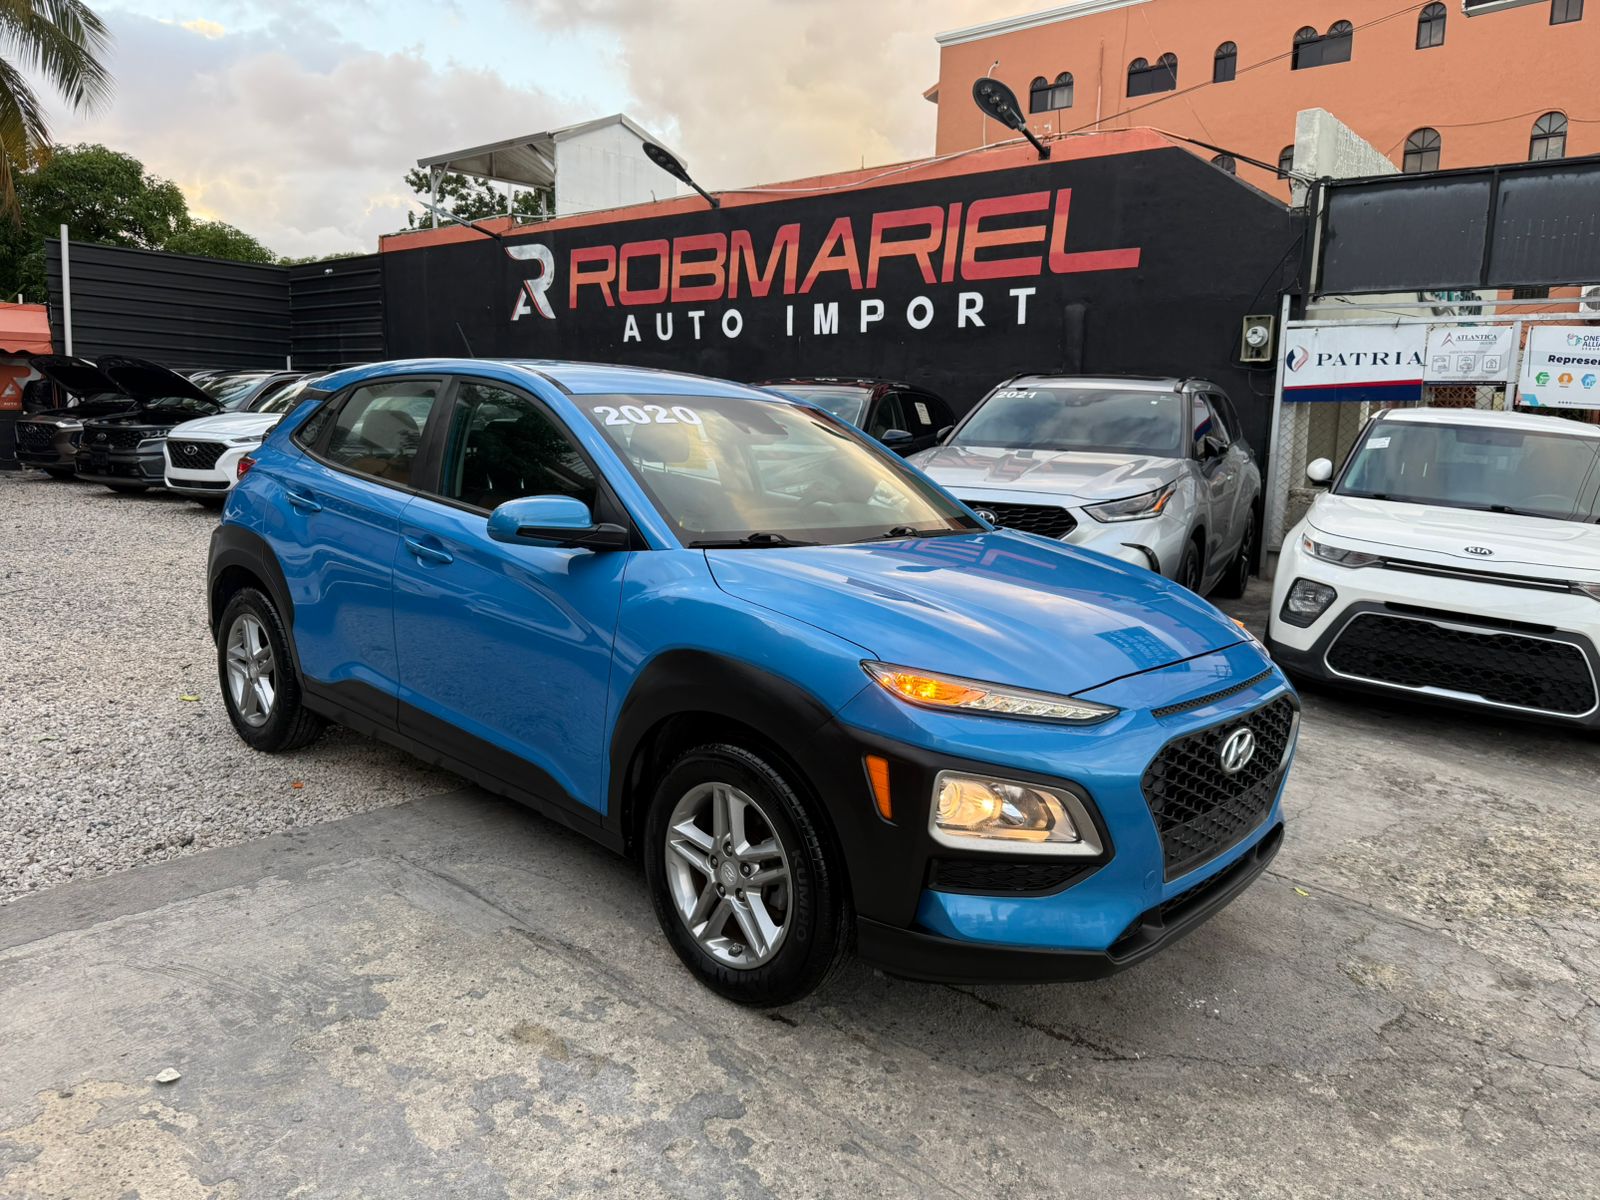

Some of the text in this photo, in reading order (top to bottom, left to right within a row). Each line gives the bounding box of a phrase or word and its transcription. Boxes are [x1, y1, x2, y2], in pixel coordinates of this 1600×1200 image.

[569, 187, 1141, 309] ROBMARIEL
[623, 287, 1037, 342] AUTO IMPORT
[1317, 351, 1423, 366] PATRIA
[995, 391, 1037, 399] 2021
[593, 405, 702, 425] 2020
[1468, 547, 1490, 555] KIA
[791, 850, 809, 942] KUMHO
